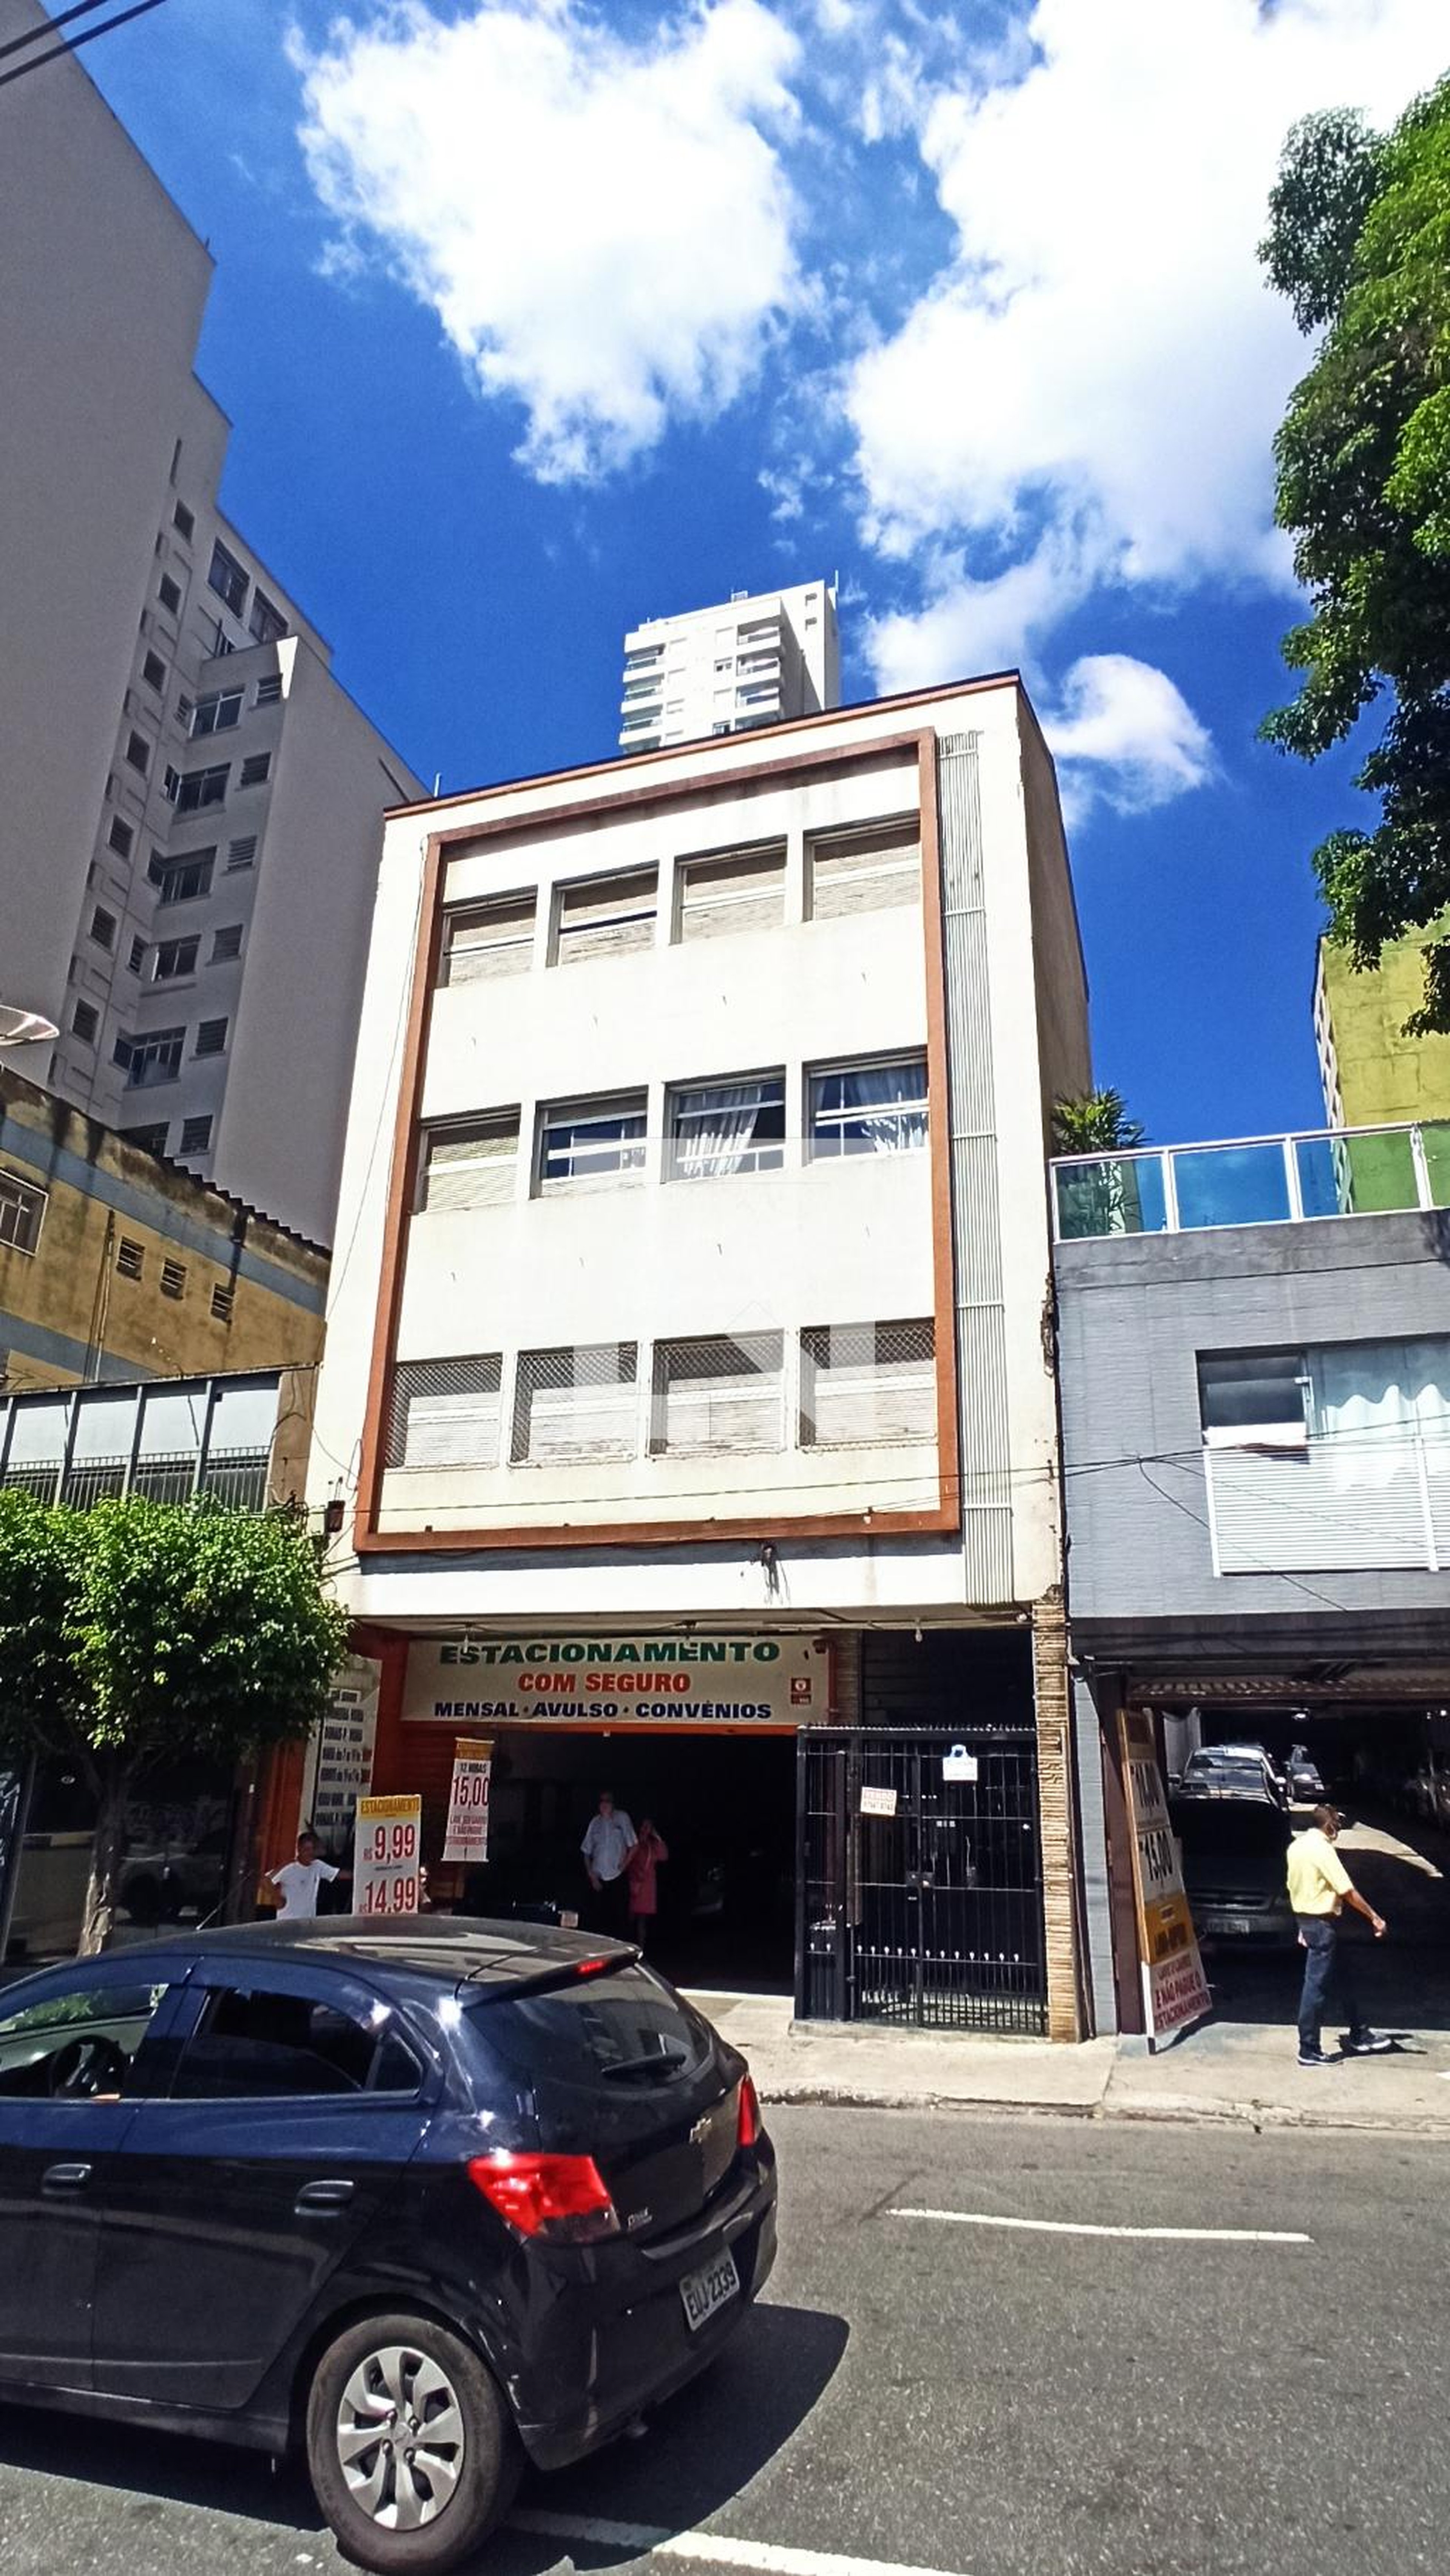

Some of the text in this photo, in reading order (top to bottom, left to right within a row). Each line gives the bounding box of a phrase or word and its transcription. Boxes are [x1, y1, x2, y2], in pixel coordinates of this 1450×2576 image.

[440, 1641, 780, 1664] ESTACIONAMENTO
[518, 1673, 691, 1693] COM SEGURO
[434, 1702, 519, 1717] MENSAL
[532, 1702, 618, 1718] AVULSO
[454, 1776, 489, 1809] 15,00
[375, 1824, 415, 1864] 9,99
